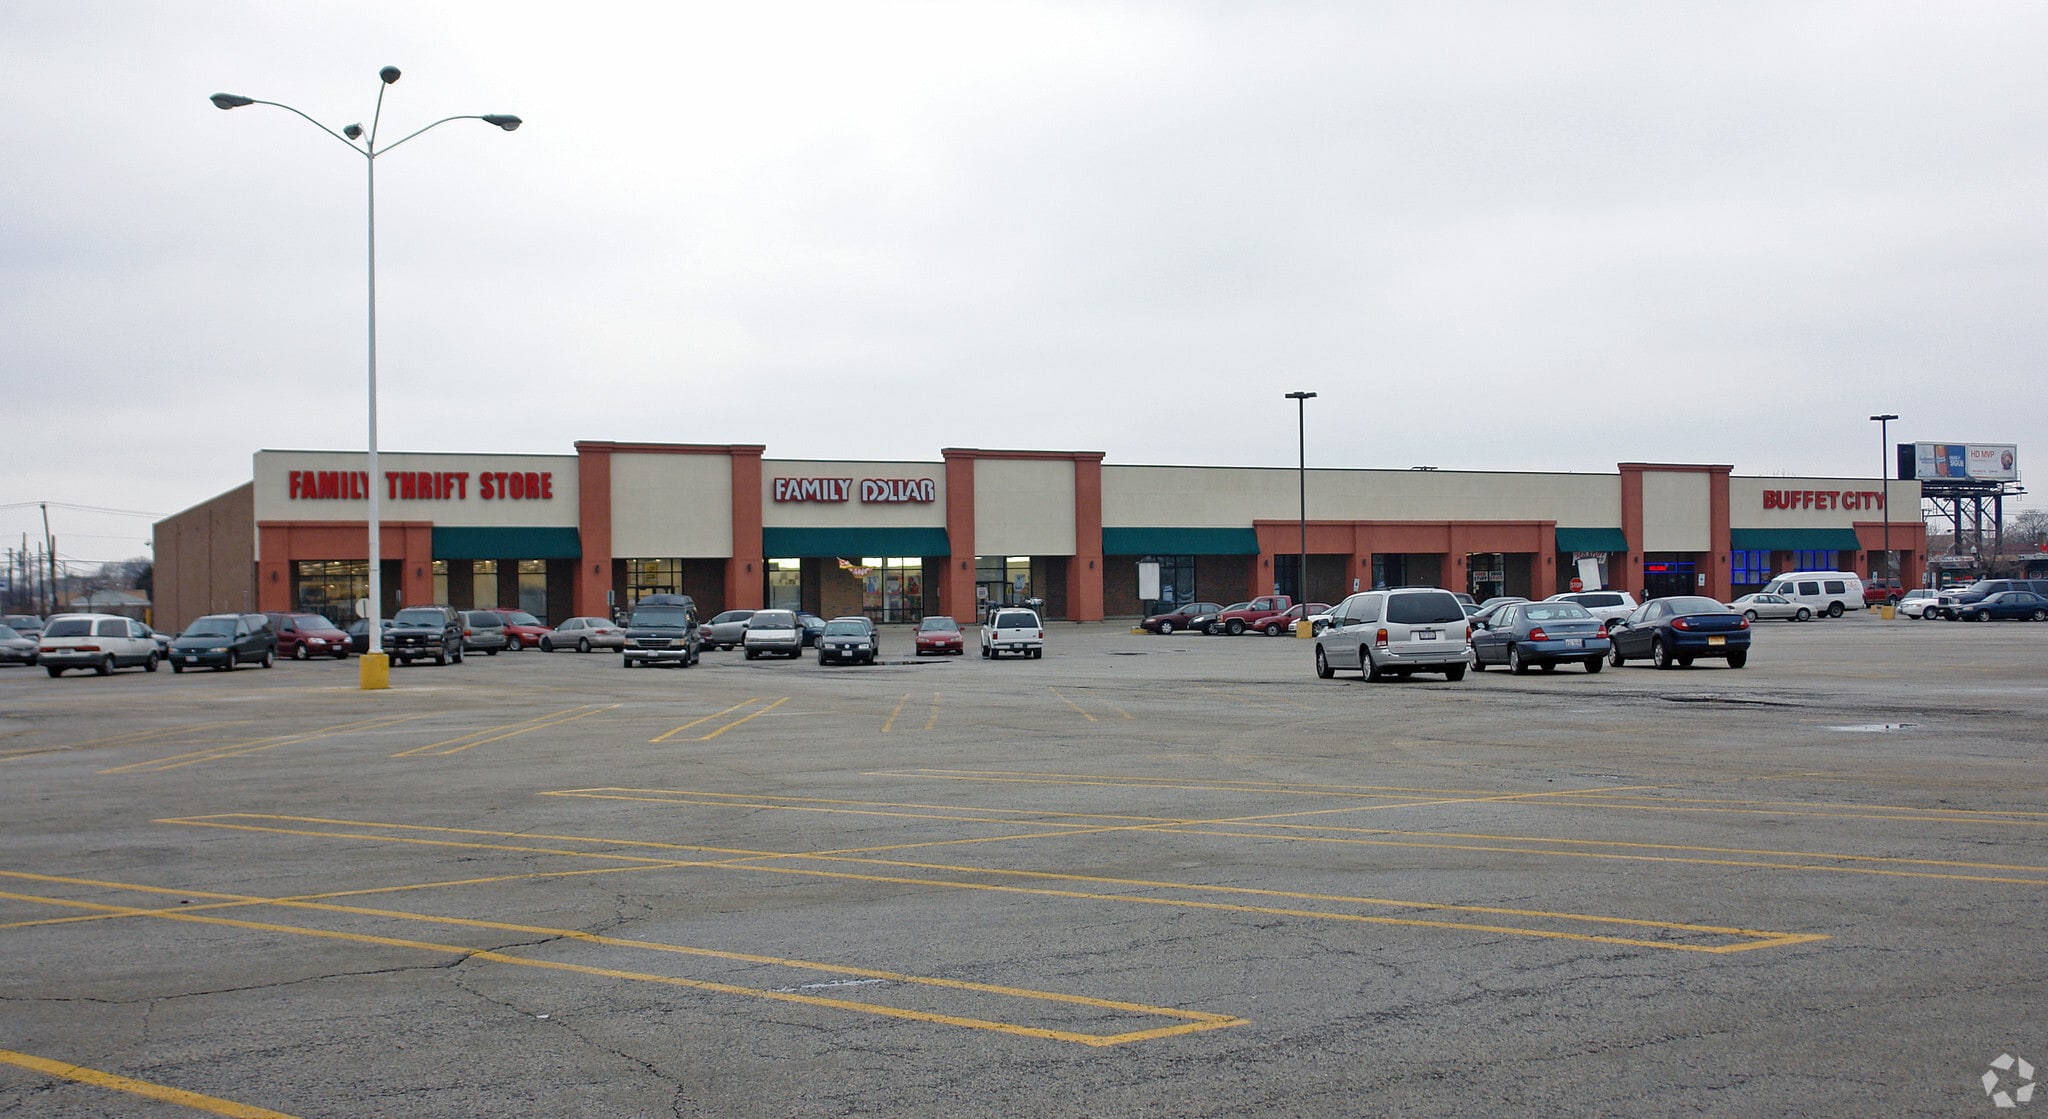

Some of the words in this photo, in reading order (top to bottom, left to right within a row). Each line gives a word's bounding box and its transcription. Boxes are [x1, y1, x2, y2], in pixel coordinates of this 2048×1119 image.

[1970, 450, 1980, 458] HD
[1981, 450, 1995, 458] MVP
[386, 471, 469, 500] THRIFT
[480, 472, 553, 500] STORE
[774, 478, 852, 501] FAMILY
[861, 479, 935, 501] DOLLAR
[1763, 490, 1840, 509] BUFFET
[1842, 491, 1885, 510] CITY
